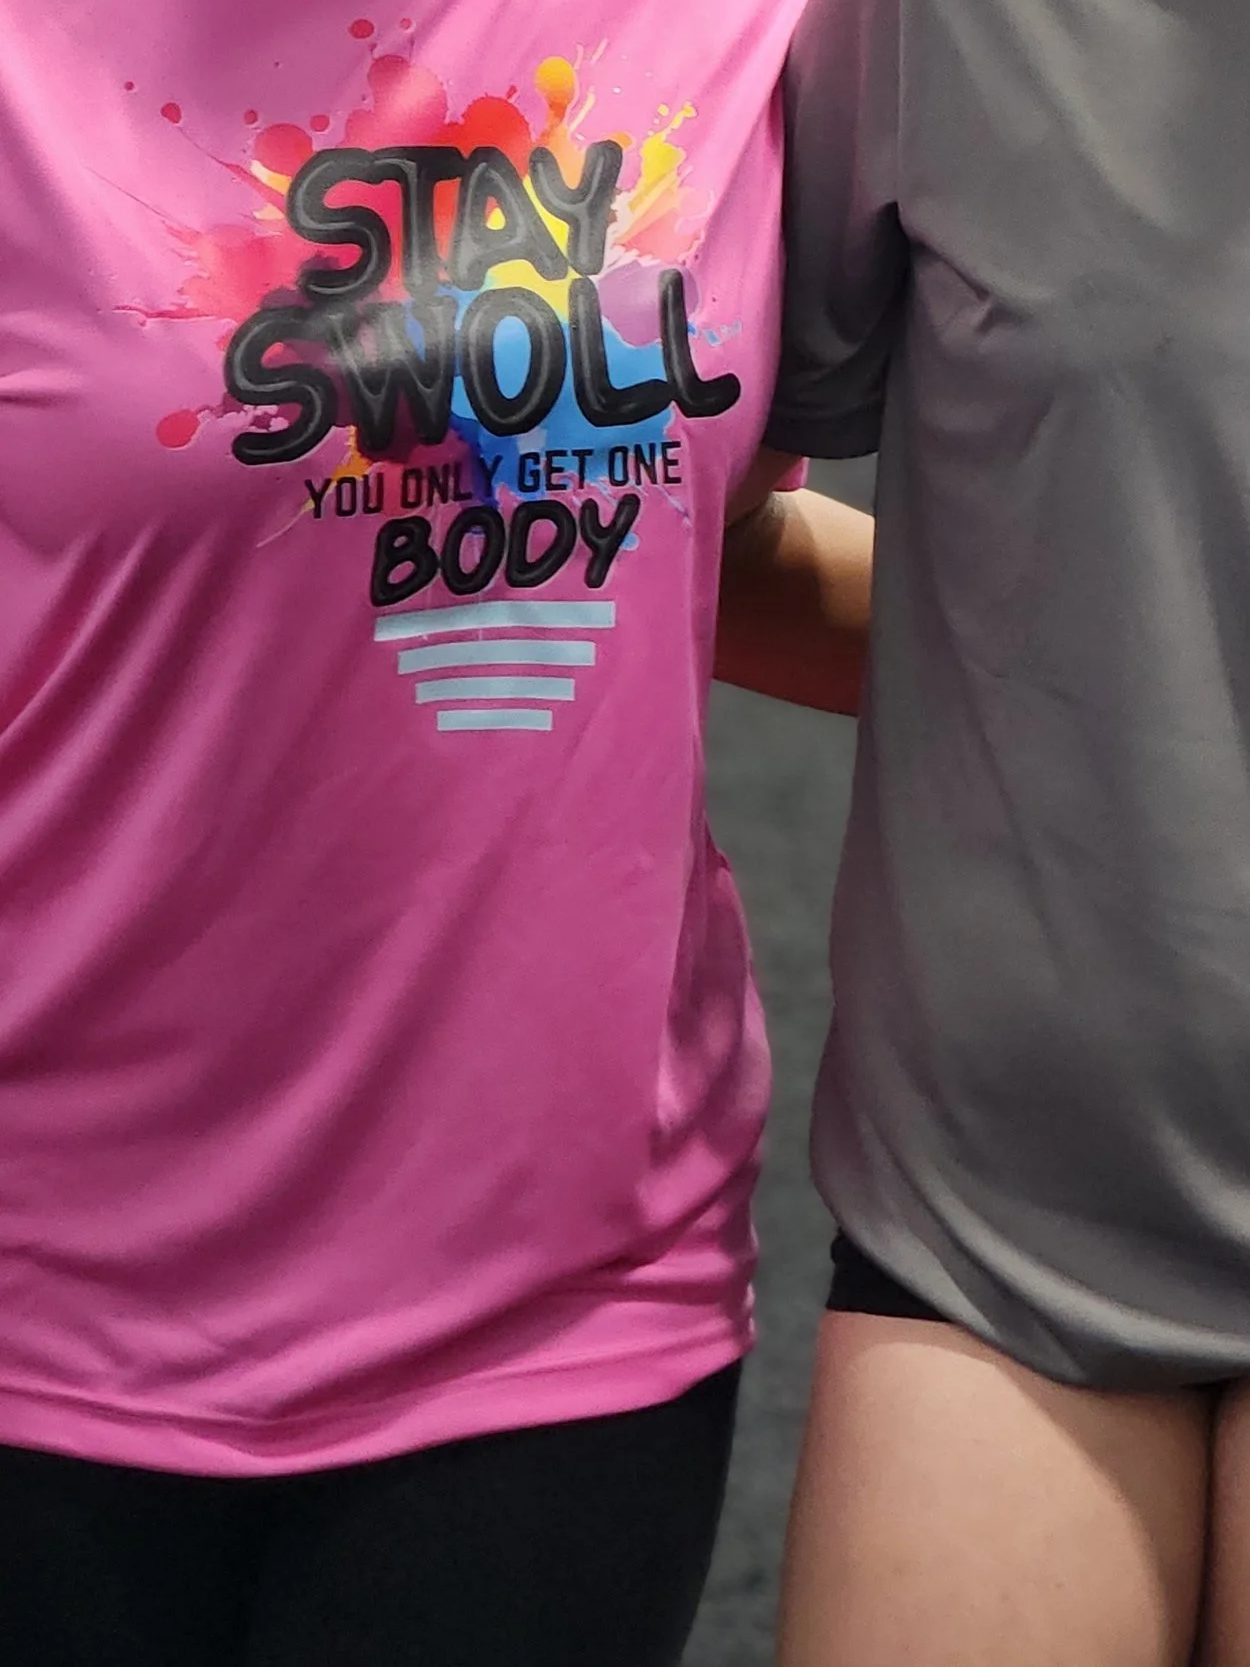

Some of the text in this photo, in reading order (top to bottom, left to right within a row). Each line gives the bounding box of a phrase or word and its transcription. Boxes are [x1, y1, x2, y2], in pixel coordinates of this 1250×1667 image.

[287, 140, 623, 295] STAY
[223, 269, 741, 465] SWOLL
[305, 440, 682, 519] YOU ONLY GET ONE
[371, 494, 641, 607] BODY
